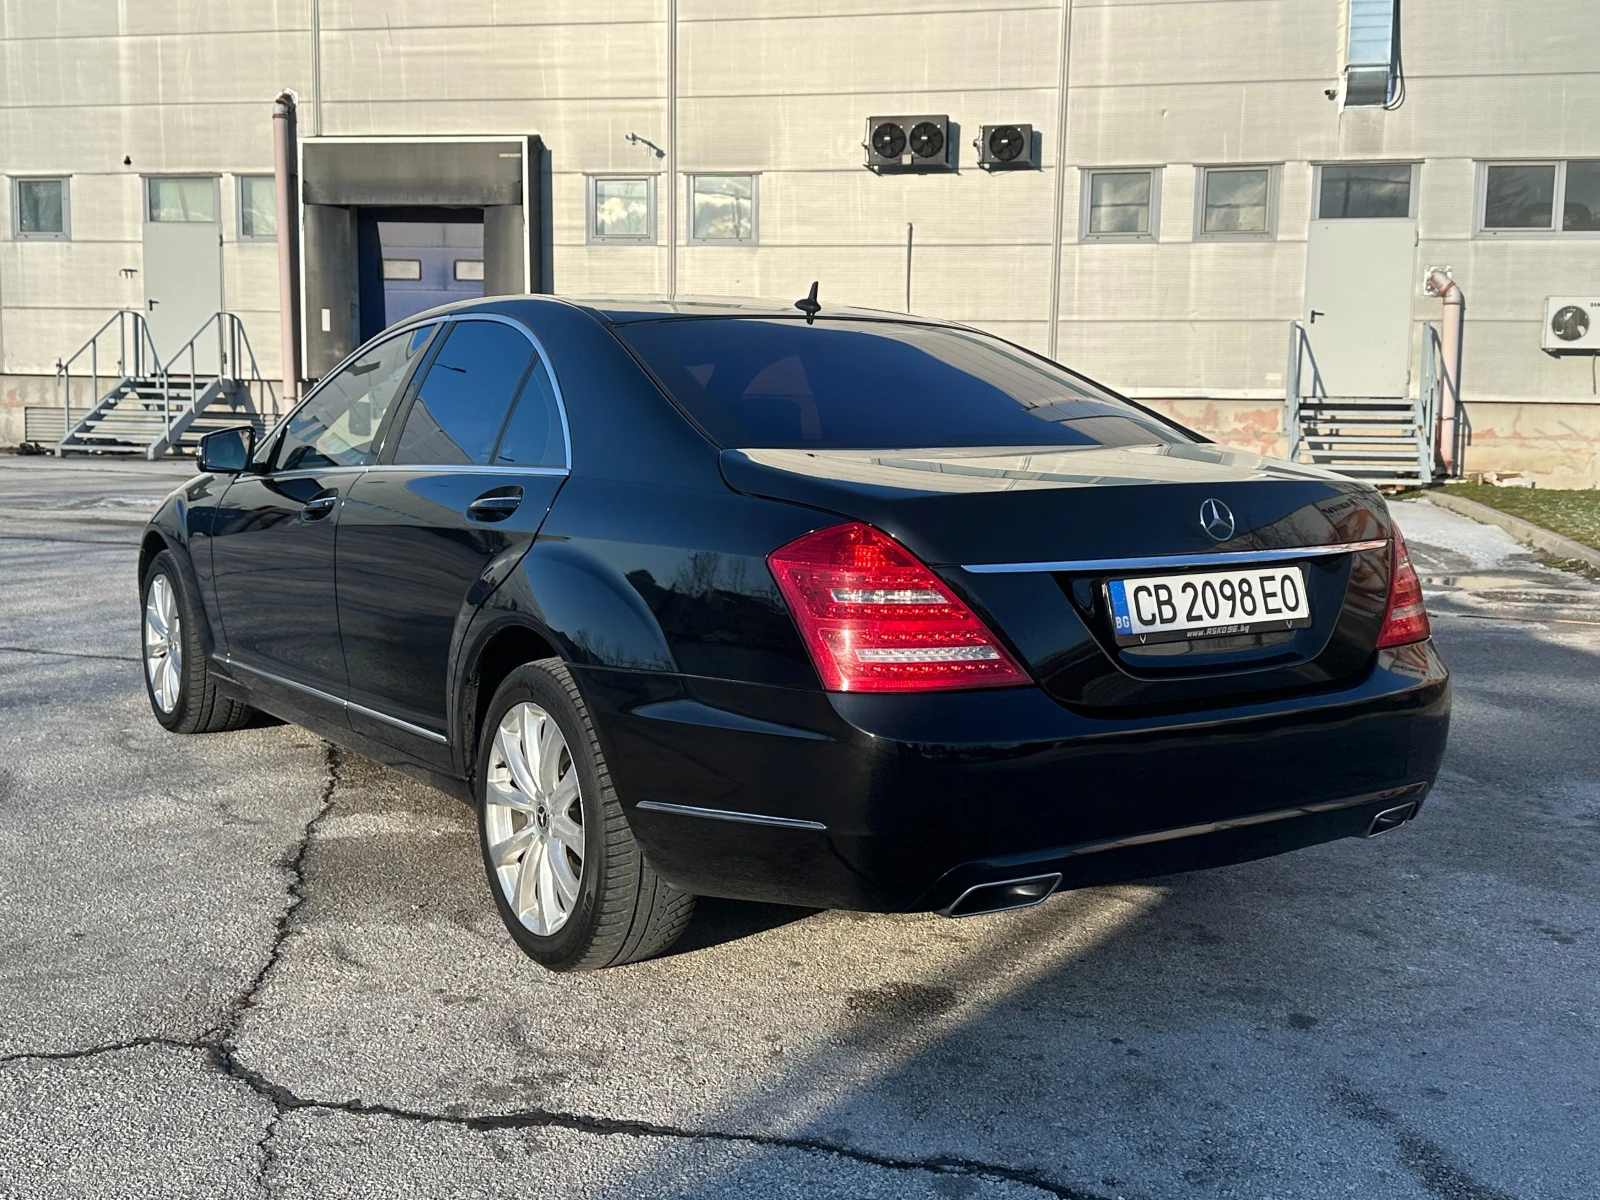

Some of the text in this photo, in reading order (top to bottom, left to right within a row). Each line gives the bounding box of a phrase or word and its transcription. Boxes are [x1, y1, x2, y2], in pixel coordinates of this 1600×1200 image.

[1133, 574, 1300, 627] CB 2098 EO
[1115, 616, 1130, 629] BG
